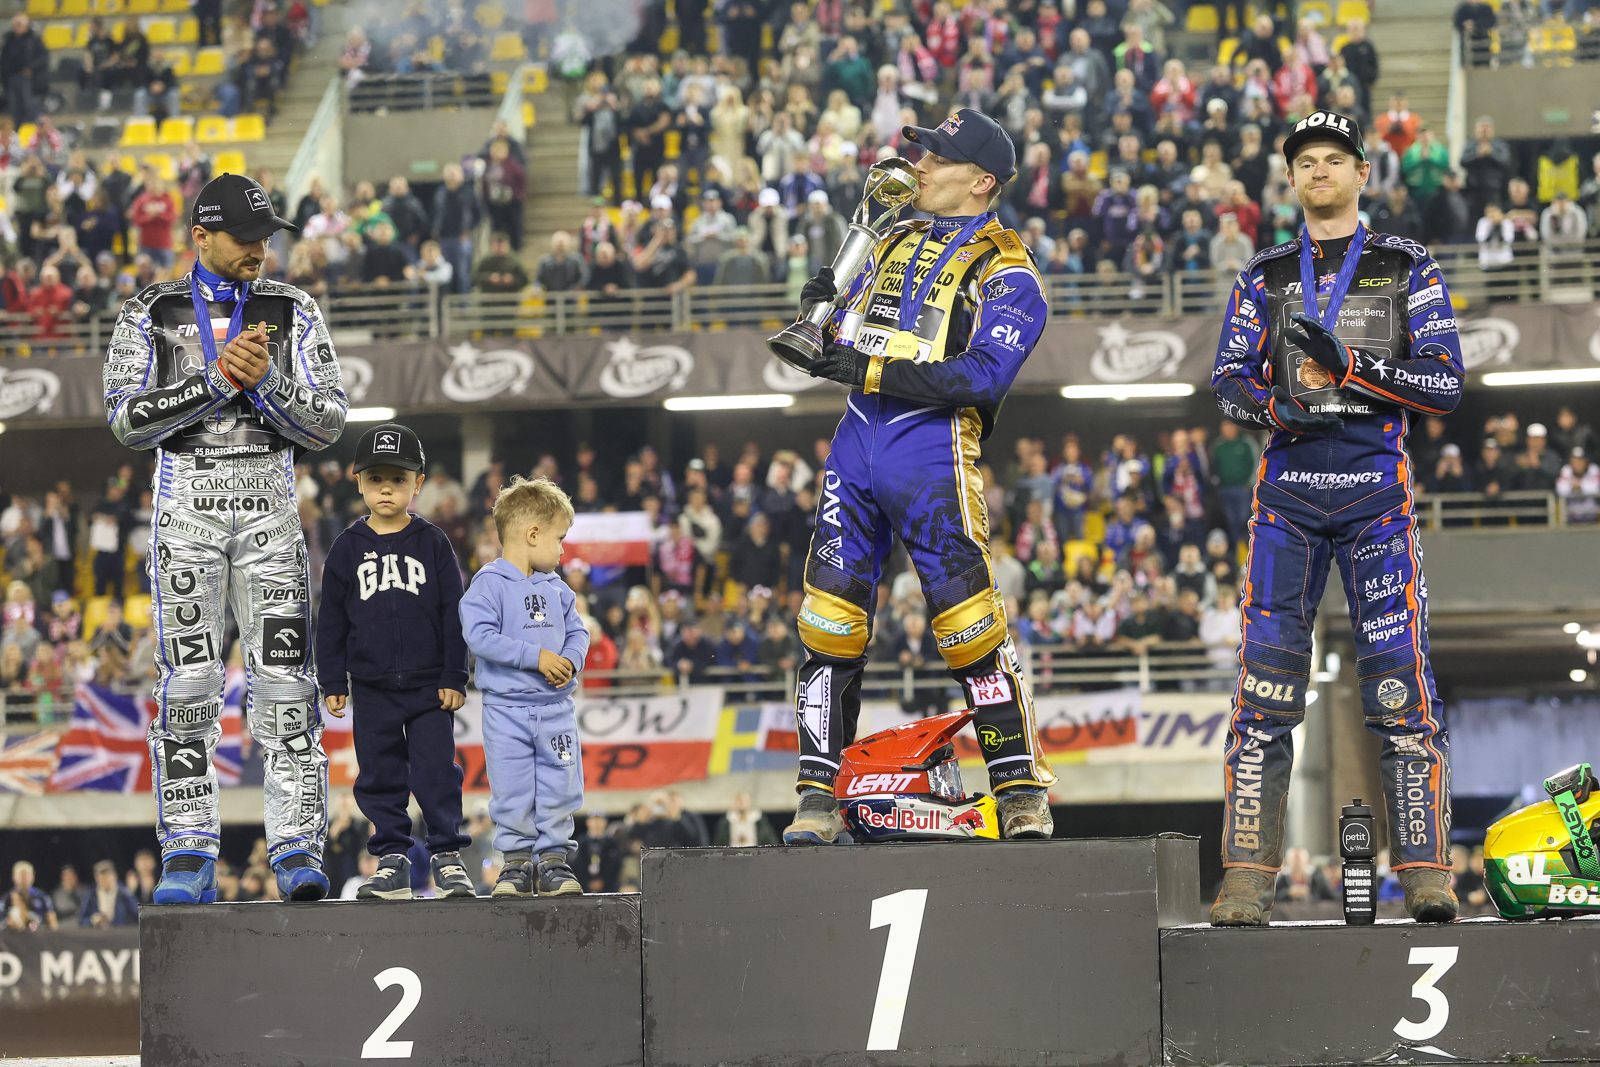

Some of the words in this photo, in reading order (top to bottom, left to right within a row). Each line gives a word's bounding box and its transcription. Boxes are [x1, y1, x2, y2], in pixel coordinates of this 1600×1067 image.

[1295, 112, 1350, 133] BOLL
[913, 264, 955, 287] WOLD
[1358, 277, 1393, 288] SGP
[247, 324, 278, 334] SP
[1230, 315, 1261, 333] BETARD
[1341, 318, 1367, 327] Frelik
[1413, 318, 1457, 340] MOTOREX
[157, 384, 204, 409] ORLEN
[1309, 405, 1320, 413] 101
[195, 447, 204, 456] 95
[376, 443, 396, 451] ORLEN
[191, 477, 273, 490] GARCAREK
[1277, 470, 1384, 484] ARMSTRONG'S
[170, 518, 215, 541] DRUTEX
[268, 515, 301, 538] DRUTEX
[1353, 543, 1388, 559] EASTERN
[1360, 550, 1384, 561] POINT
[356, 553, 427, 601] GAP
[1365, 577, 1379, 592] M
[1382, 573, 1395, 586] &
[1397, 569, 1403, 584] J
[1366, 582, 1406, 602] Sealey
[524, 594, 547, 611] GAP
[804, 610, 848, 635] MOTOREX
[1362, 609, 1408, 633] Richard
[1368, 624, 1405, 643] Hayes
[270, 649, 300, 658] ORLEN
[978, 686, 1005, 701] RA
[1243, 673, 1295, 702] BOLL
[169, 703, 219, 724] PROFBUD
[822, 674, 830, 741] ROGOWO
[550, 734, 572, 751] GAP
[298, 752, 317, 828] DRUTEX
[847, 773, 922, 796] LEATT
[1396, 760, 1405, 801] Flooring
[163, 782, 213, 801] ORLEN
[181, 802, 199, 813] OIL
[1396, 801, 1405, 814] by
[1407, 761, 1431, 846] Choices
[858, 804, 898, 829] Red
[901, 809, 941, 830] Bull
[1345, 832, 1366, 845] petit
[1398, 814, 1407, 847] Brights
[1559, 802, 1594, 859] OAKLEY
[165, 838, 209, 849] GARCAREK
[1344, 868, 1371, 877] Tobiasz
[1344, 878, 1371, 887] Herman
[866, 889, 928, 1050] 1
[1392, 945, 1459, 1041] 3
[361, 966, 422, 1059] 2
